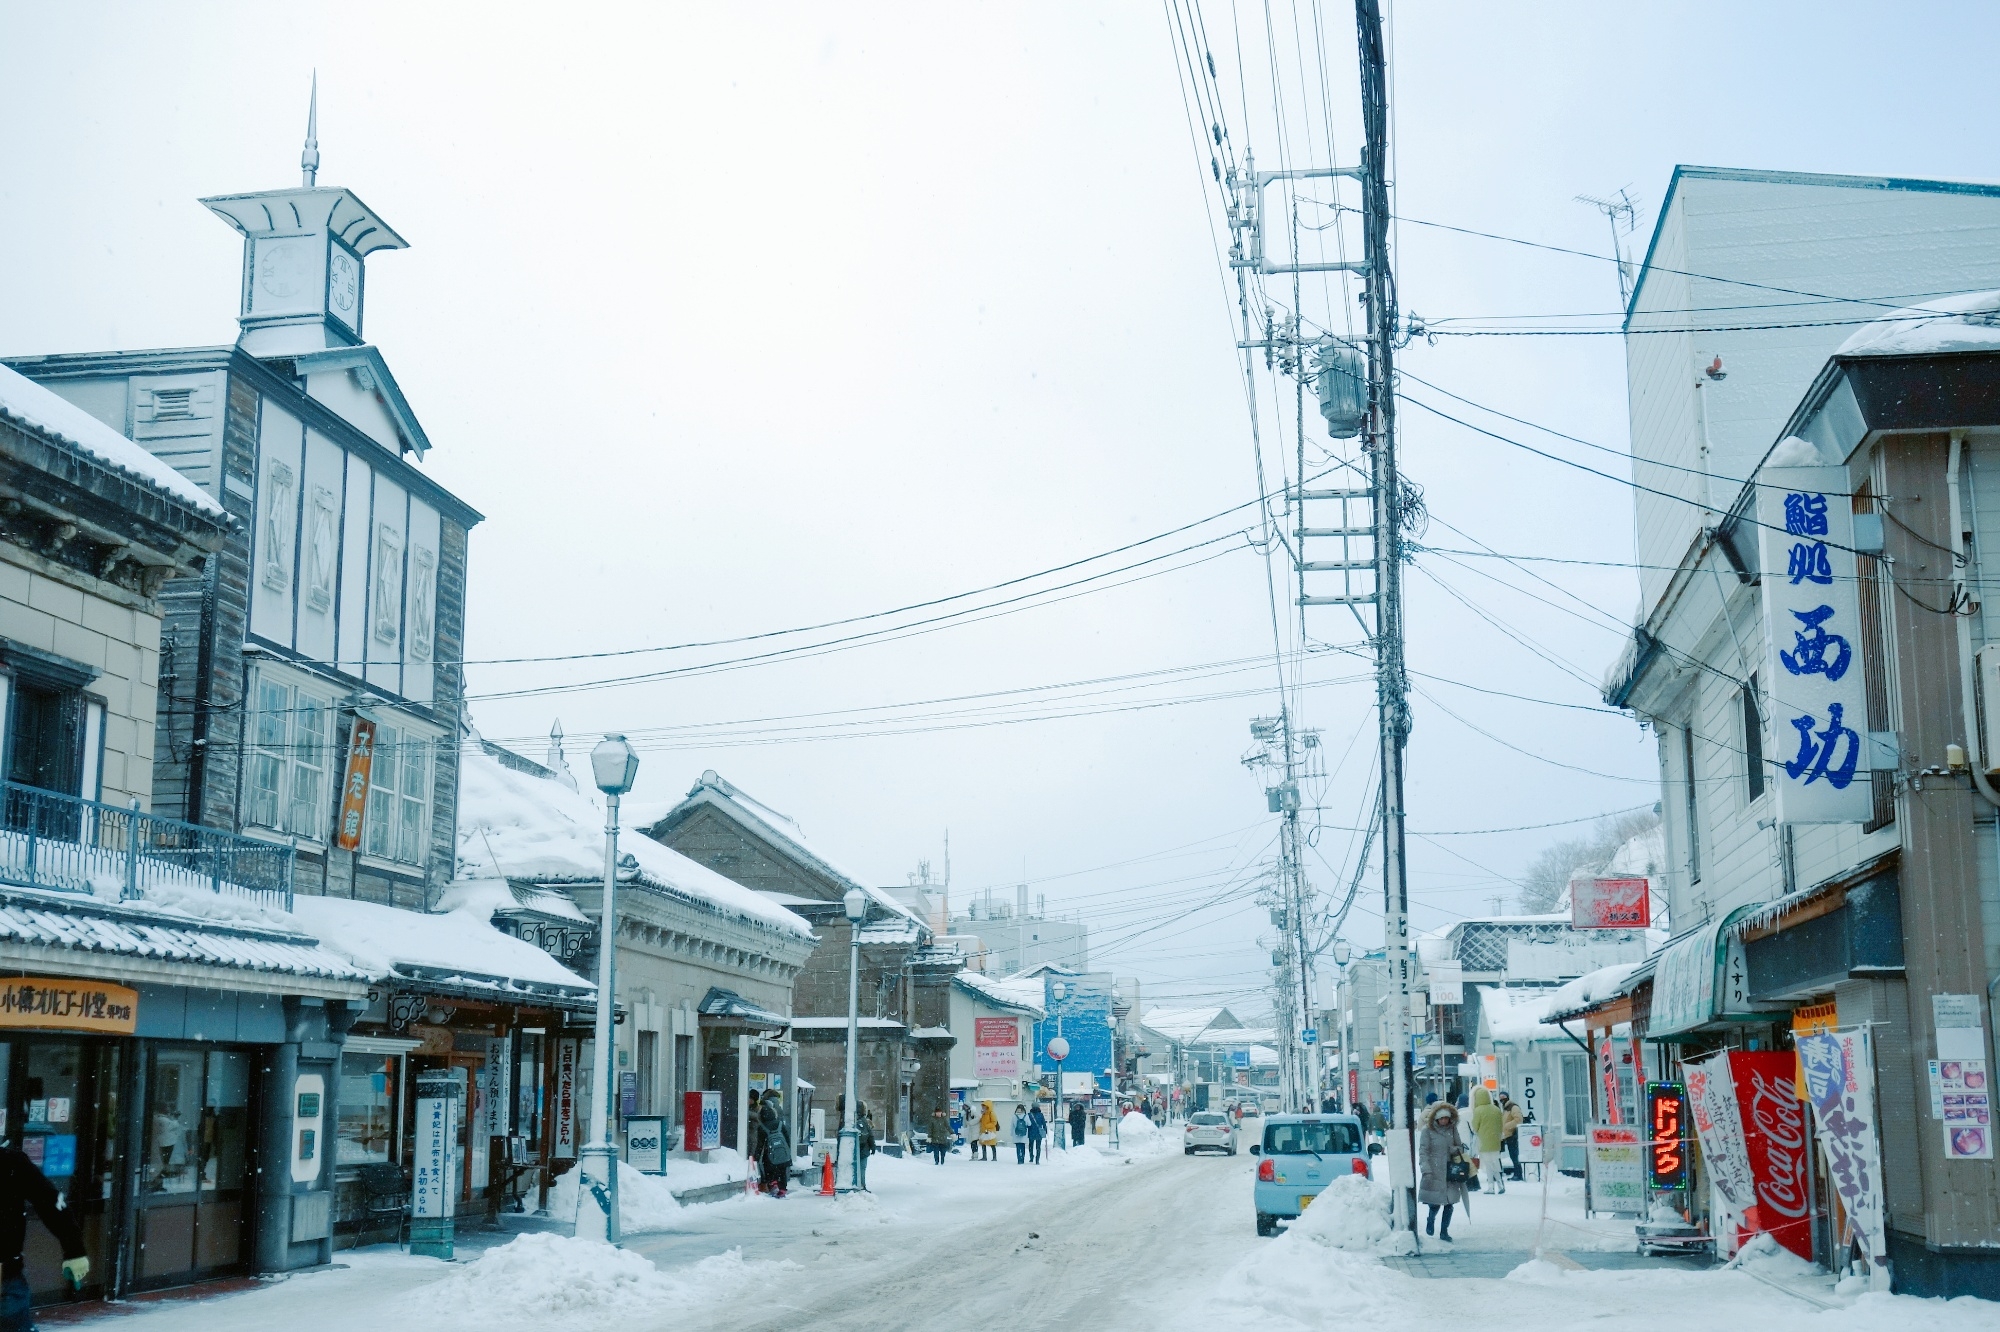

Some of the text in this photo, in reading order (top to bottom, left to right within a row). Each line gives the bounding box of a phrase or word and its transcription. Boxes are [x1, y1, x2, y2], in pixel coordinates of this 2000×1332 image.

[1779, 492, 1861, 789] 鮨処 西功
[1731, 956, 1744, 1003] くすり
[1524, 1077, 1536, 1121] POLA
[1655, 1098, 1679, 1174] ドリンク
[1752, 1067, 1808, 1218] Coca-Cola
